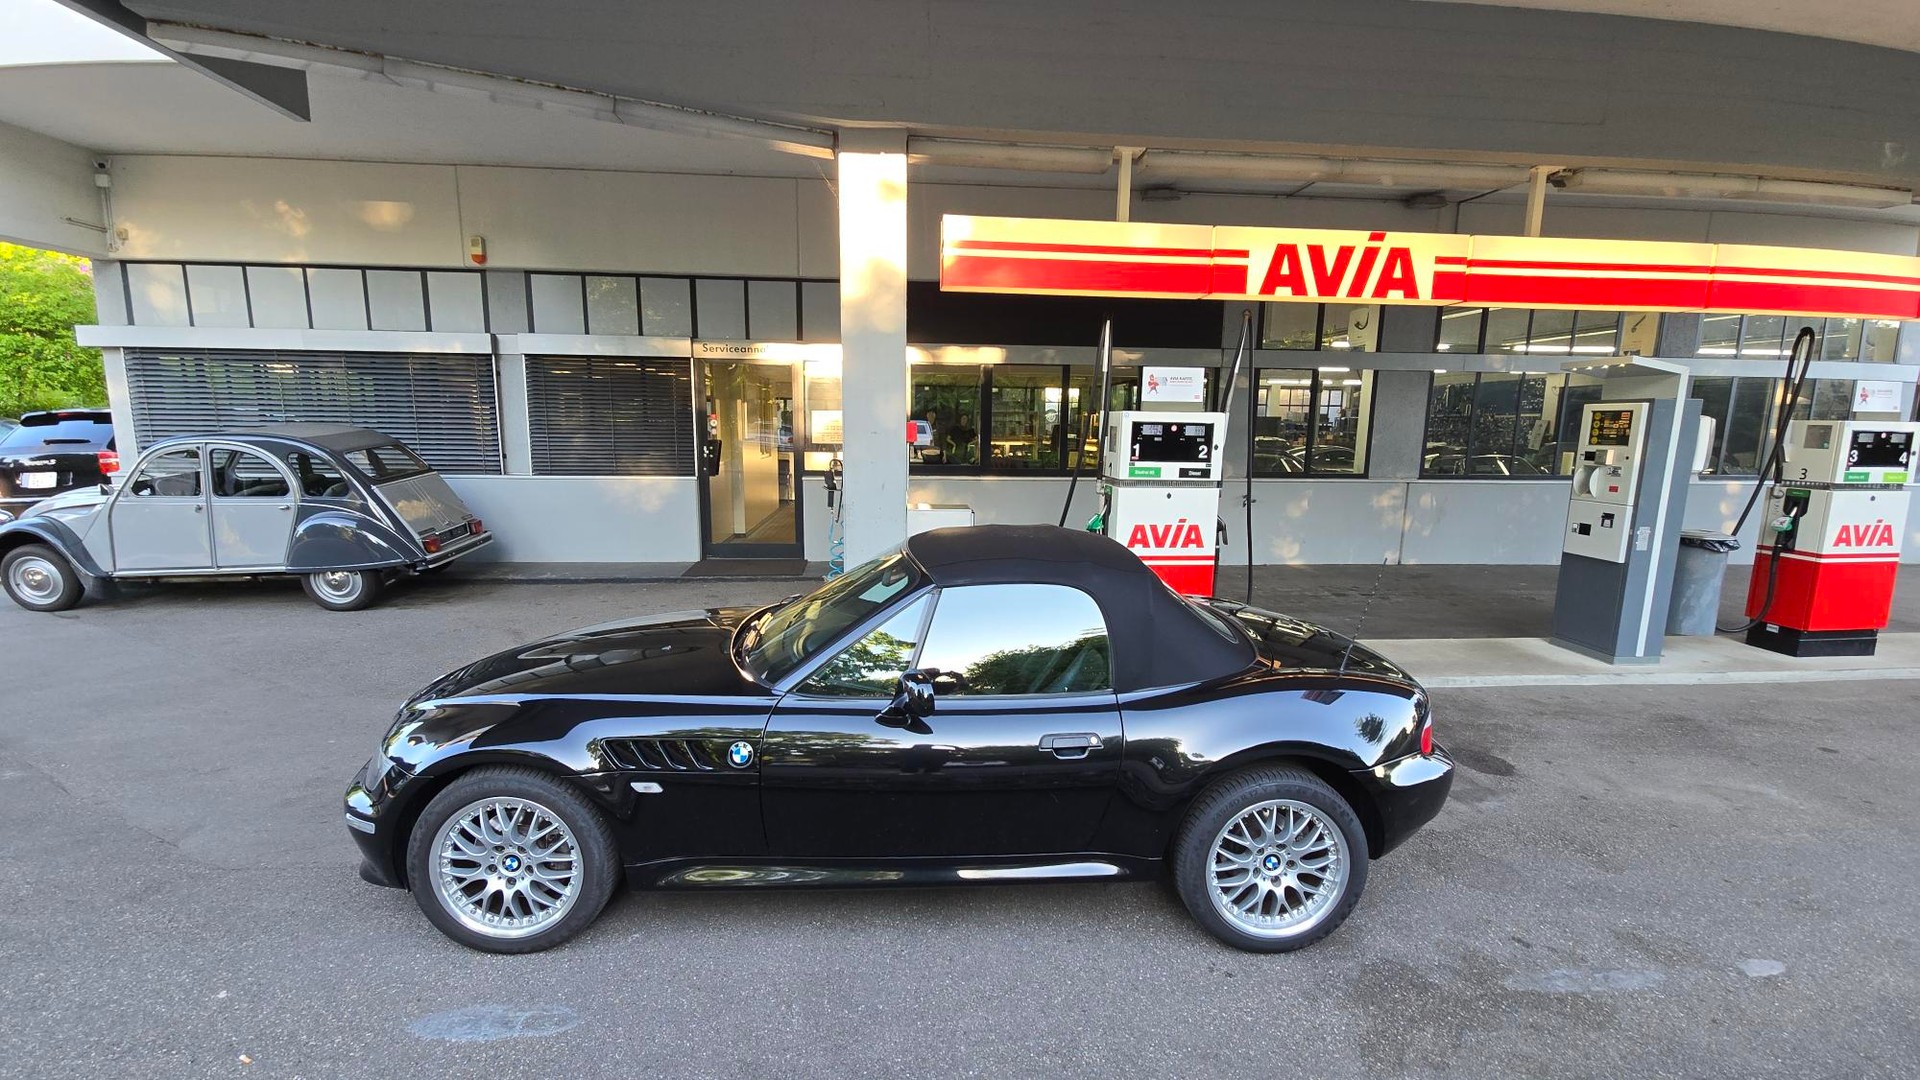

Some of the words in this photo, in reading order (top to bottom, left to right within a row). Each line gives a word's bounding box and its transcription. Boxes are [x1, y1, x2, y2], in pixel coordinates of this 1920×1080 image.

[1259, 230, 1420, 300] AVIA
[1132, 443, 1140, 457] 1
[1198, 445, 1208, 459] 2
[1849, 449, 1859, 462] 3
[1898, 451, 1908, 464] 4
[1799, 468, 1808, 480] 3
[1127, 518, 1204, 548] AVIA
[1832, 519, 1894, 547] AVIA
